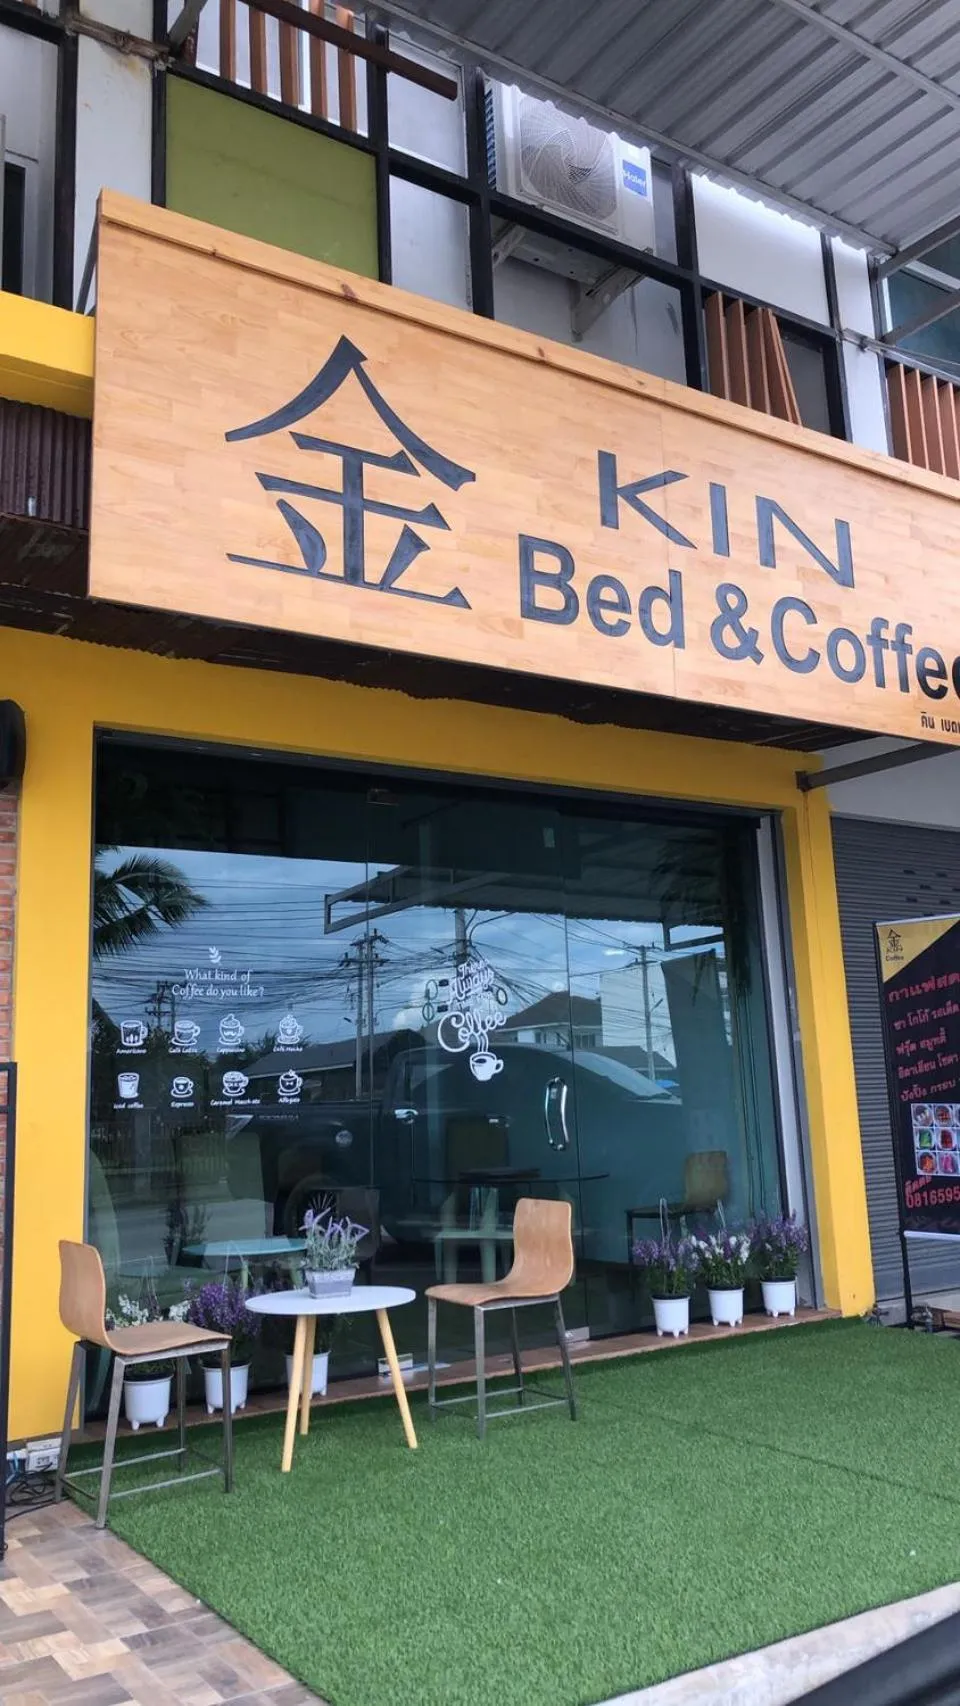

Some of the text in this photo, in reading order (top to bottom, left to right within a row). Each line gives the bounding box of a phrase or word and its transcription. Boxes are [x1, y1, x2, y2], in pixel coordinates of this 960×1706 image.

[225, 334, 476, 610] 金
[598, 450, 855, 588] KIN
[518, 533, 686, 649] Bed
[171, 983, 265, 1000] Coffee do you like?
[183, 968, 254, 985] What kind of
[438, 1009, 507, 1053] Coffee
